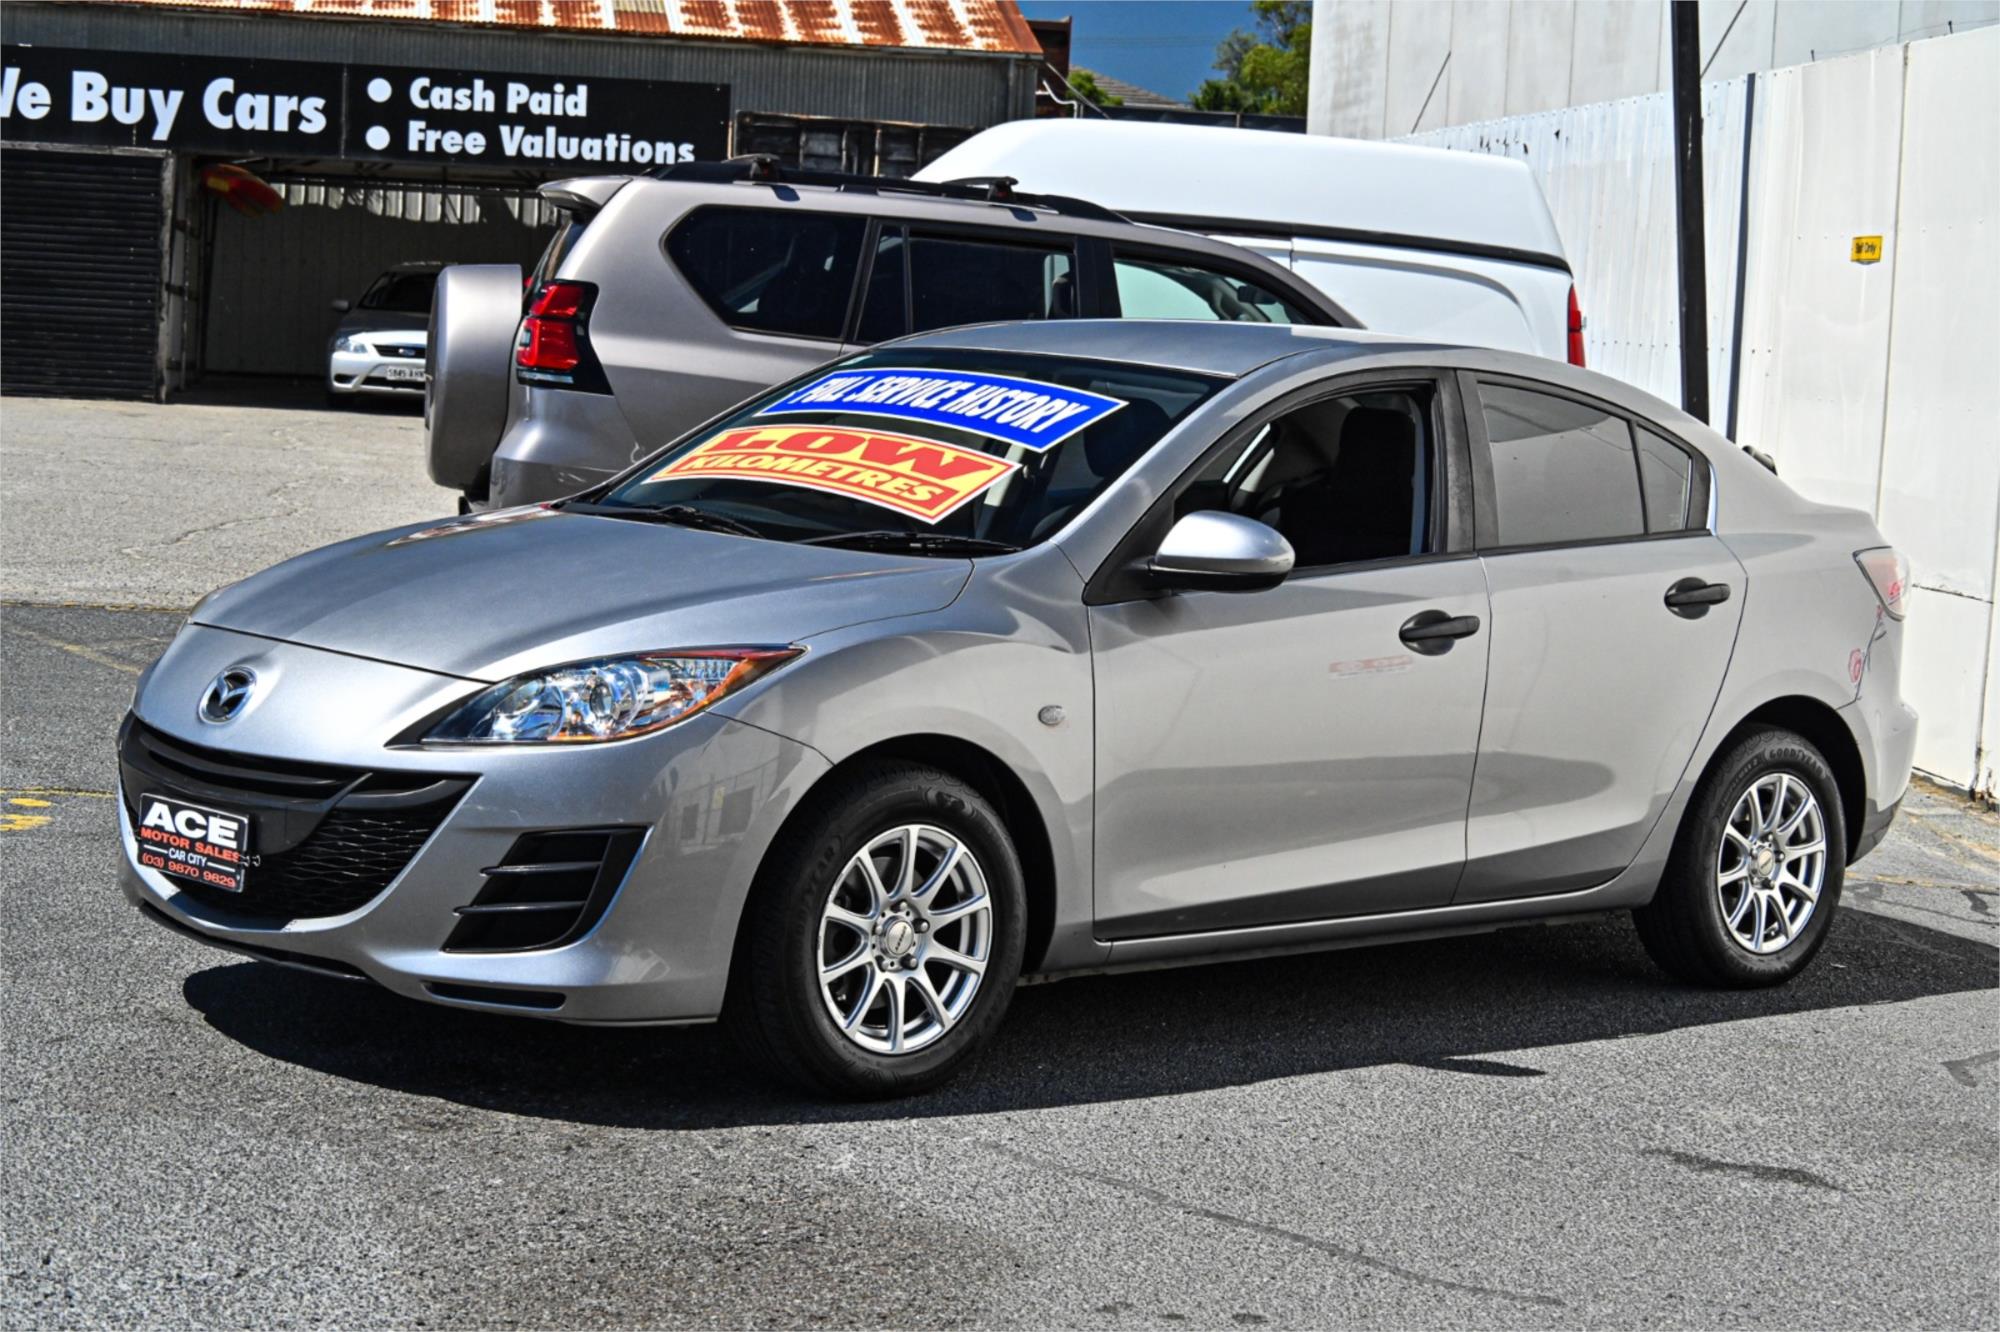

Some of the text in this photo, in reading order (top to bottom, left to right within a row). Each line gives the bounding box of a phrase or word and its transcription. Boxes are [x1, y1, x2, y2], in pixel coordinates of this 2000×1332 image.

[71, 70, 184, 141] Buy
[202, 77, 327, 134] Cars
[409, 77, 588, 117] Cash Paid
[408, 120, 695, 165] Free Valuations
[787, 376, 1091, 433] FULL SERVICE HISTORY
[684, 453, 944, 501] KILOMETRES
[702, 431, 994, 482] LOW
[141, 827, 240, 863] MOTOR SALES
[142, 801, 239, 849] ACE
[142, 852, 236, 888] (03) 9870 9829
[168, 848, 207, 867] CAR CITY
